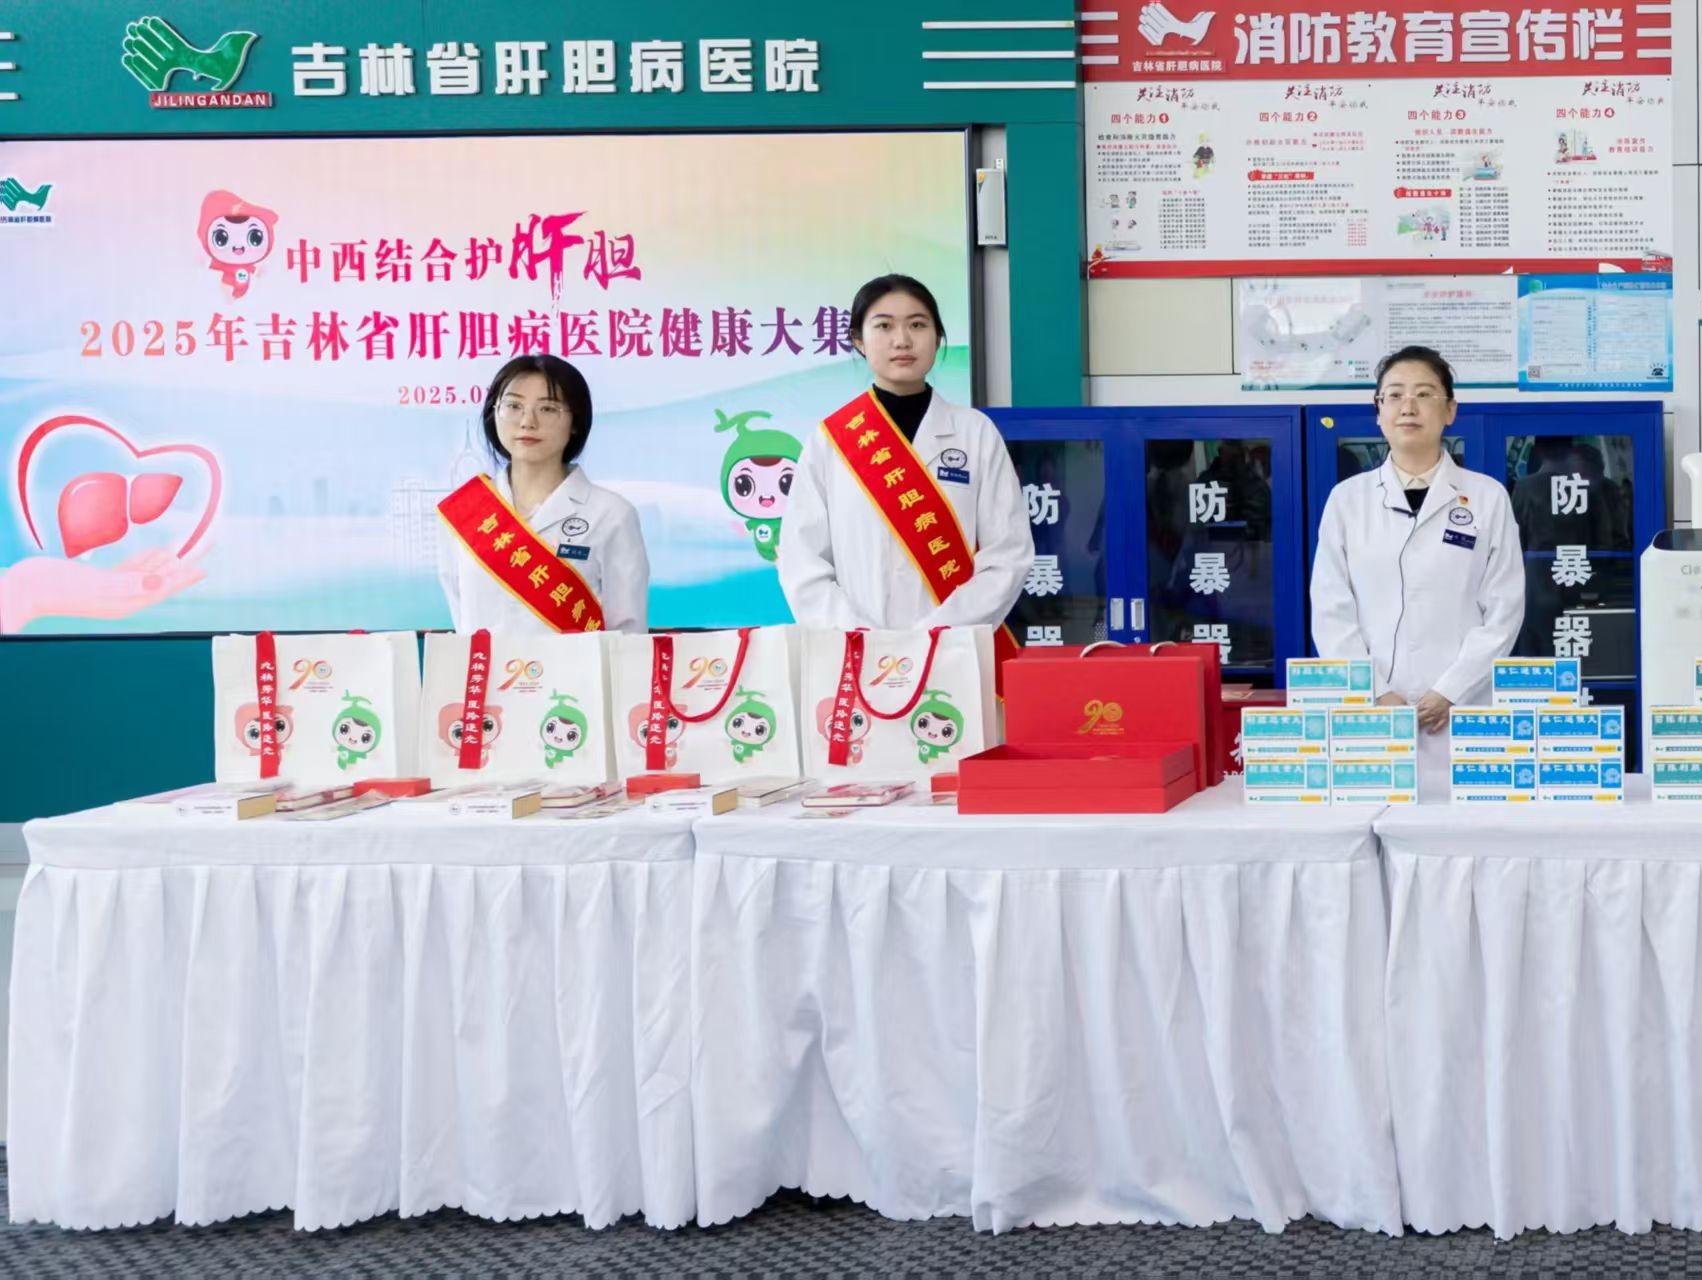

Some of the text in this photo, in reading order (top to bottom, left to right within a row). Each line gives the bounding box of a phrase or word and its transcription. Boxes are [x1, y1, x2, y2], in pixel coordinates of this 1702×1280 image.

[1234, 8, 1623, 65] 消防教育宣传栏
[291, 39, 820, 95] 吉林省肝胆病医院
[1132, 60, 1223, 72] 吉林省肝胆病医院
[153, 93, 267, 108] JILINGANDAN
[399, 385, 490, 404] 2025.0
[845, 410, 961, 581] 吉林省肝胆病医院
